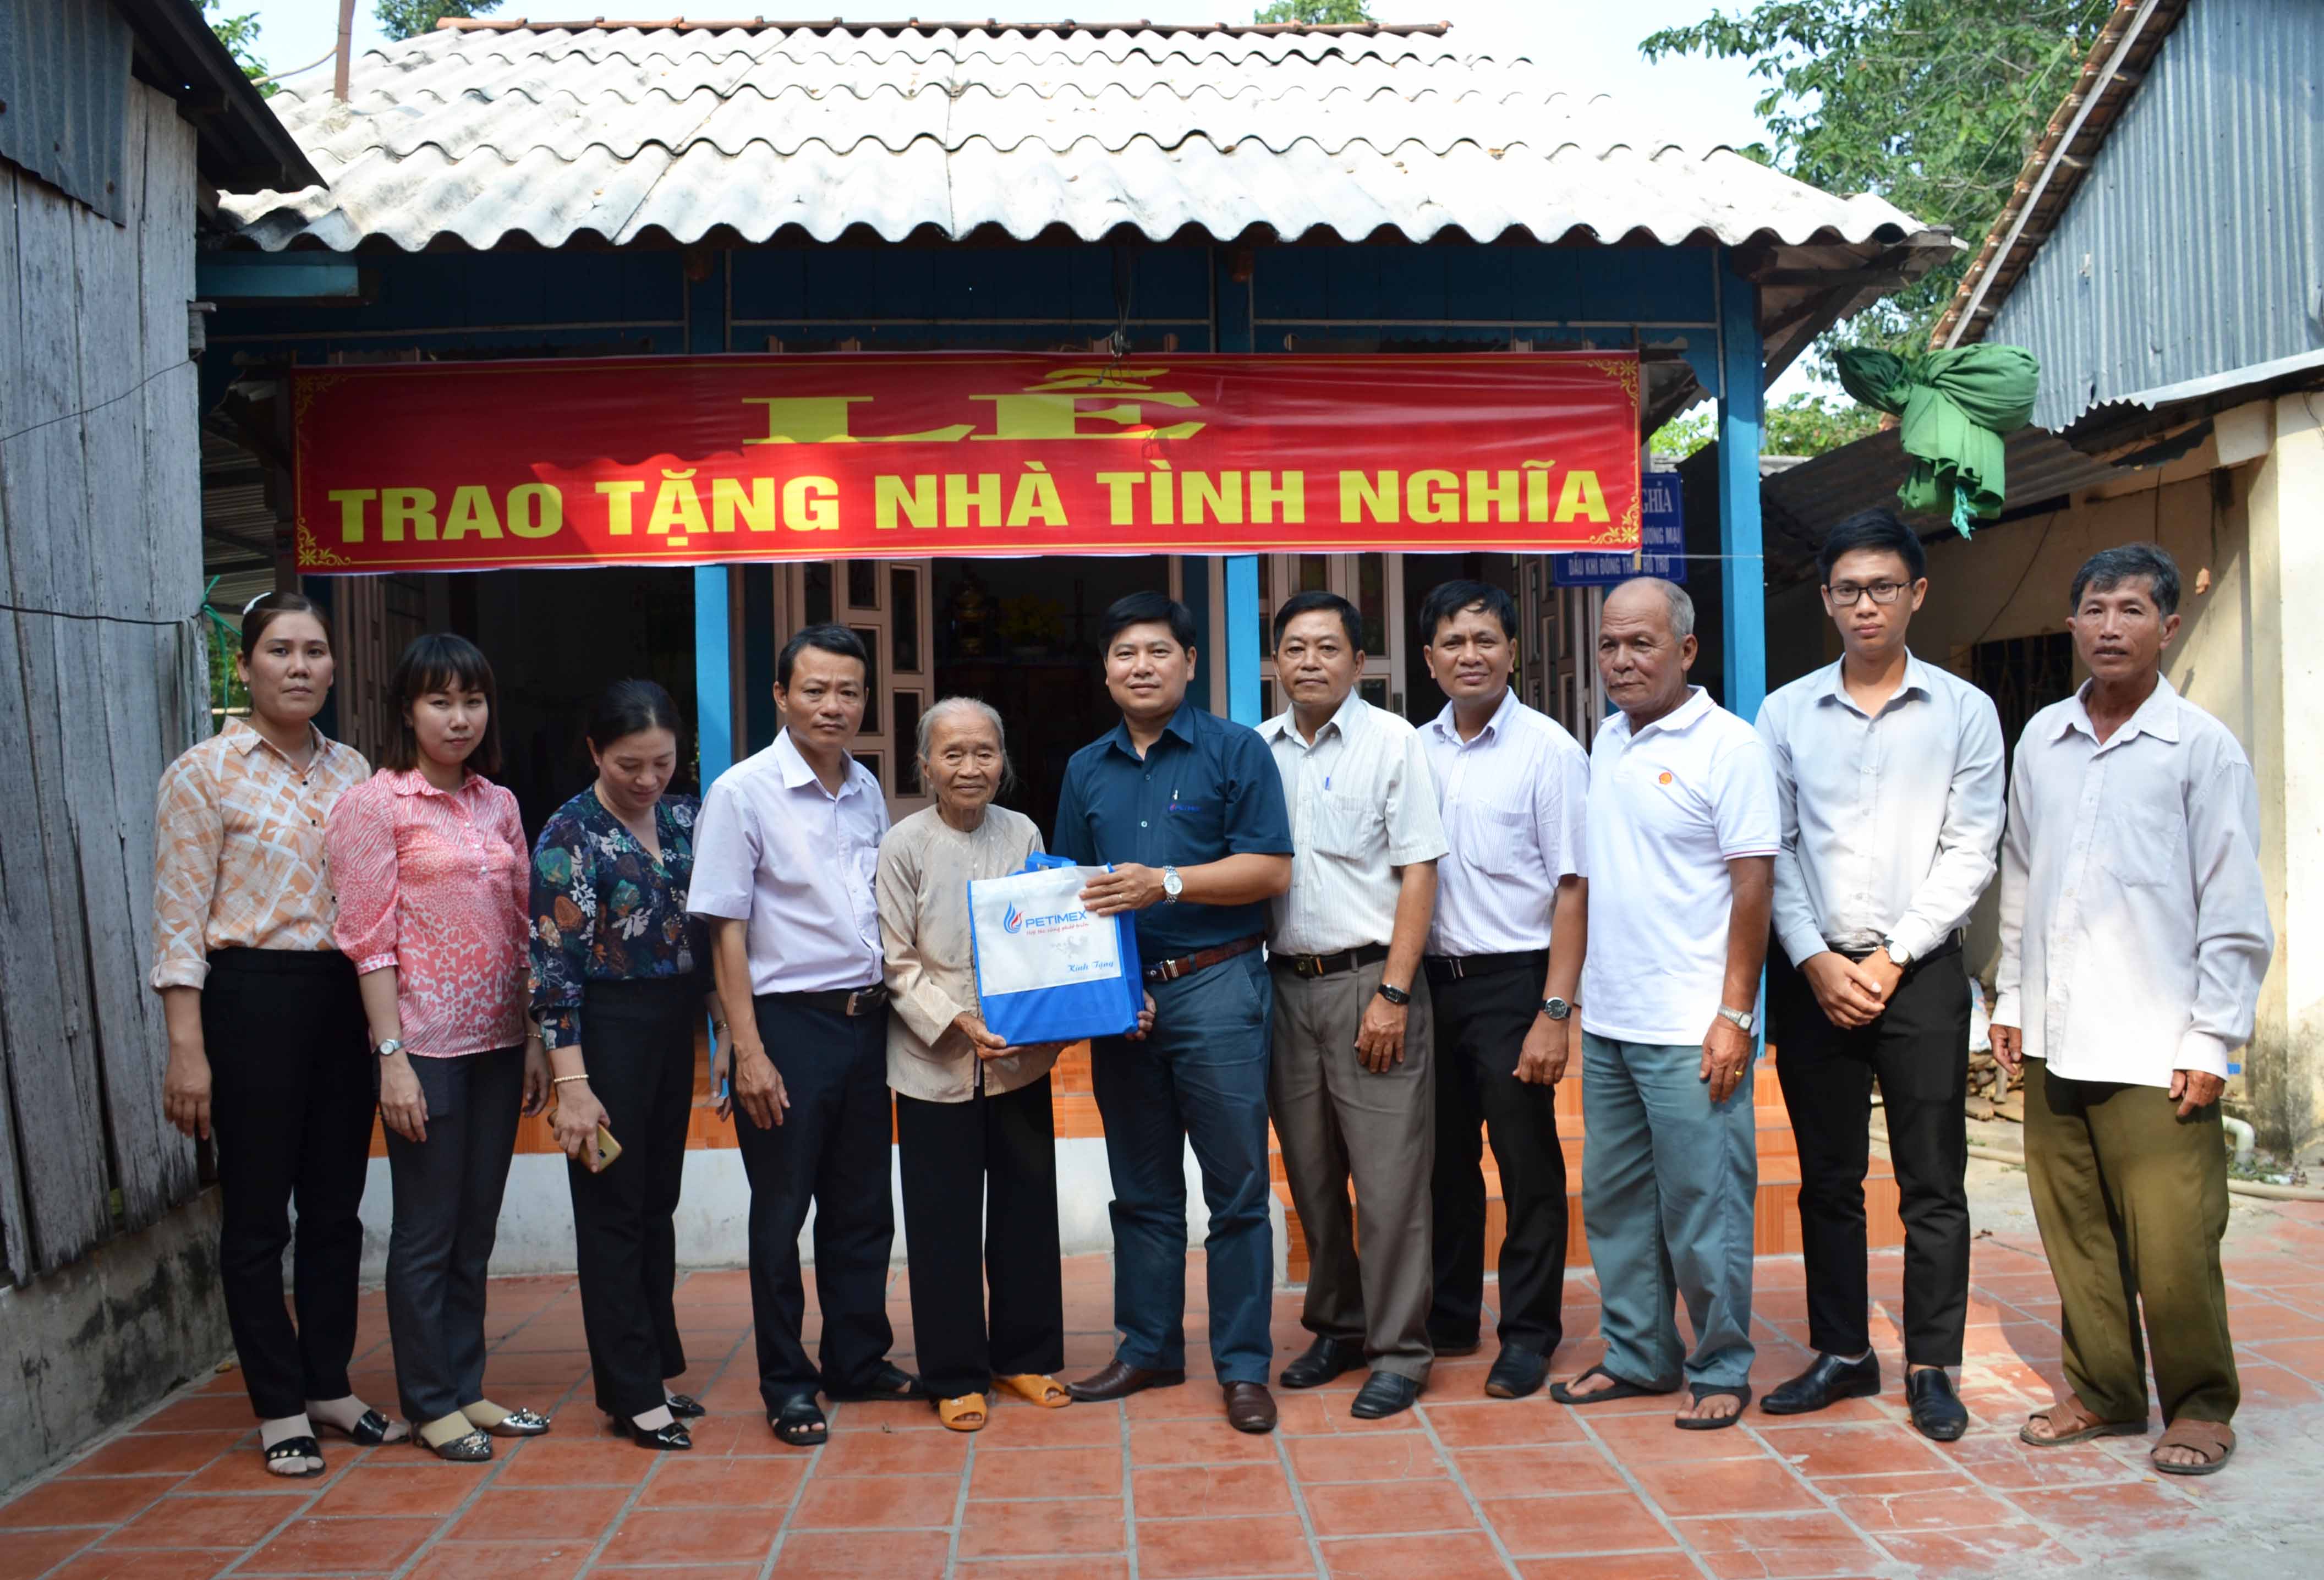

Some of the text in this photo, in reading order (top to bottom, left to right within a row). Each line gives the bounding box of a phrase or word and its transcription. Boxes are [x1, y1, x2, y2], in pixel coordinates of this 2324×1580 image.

[742, 368, 1207, 443] LỄ
[329, 459, 1610, 546] TRAO TẶNG NHÀ TÌNH NGHĨA
[1026, 910, 1087, 928] PETIMEX
